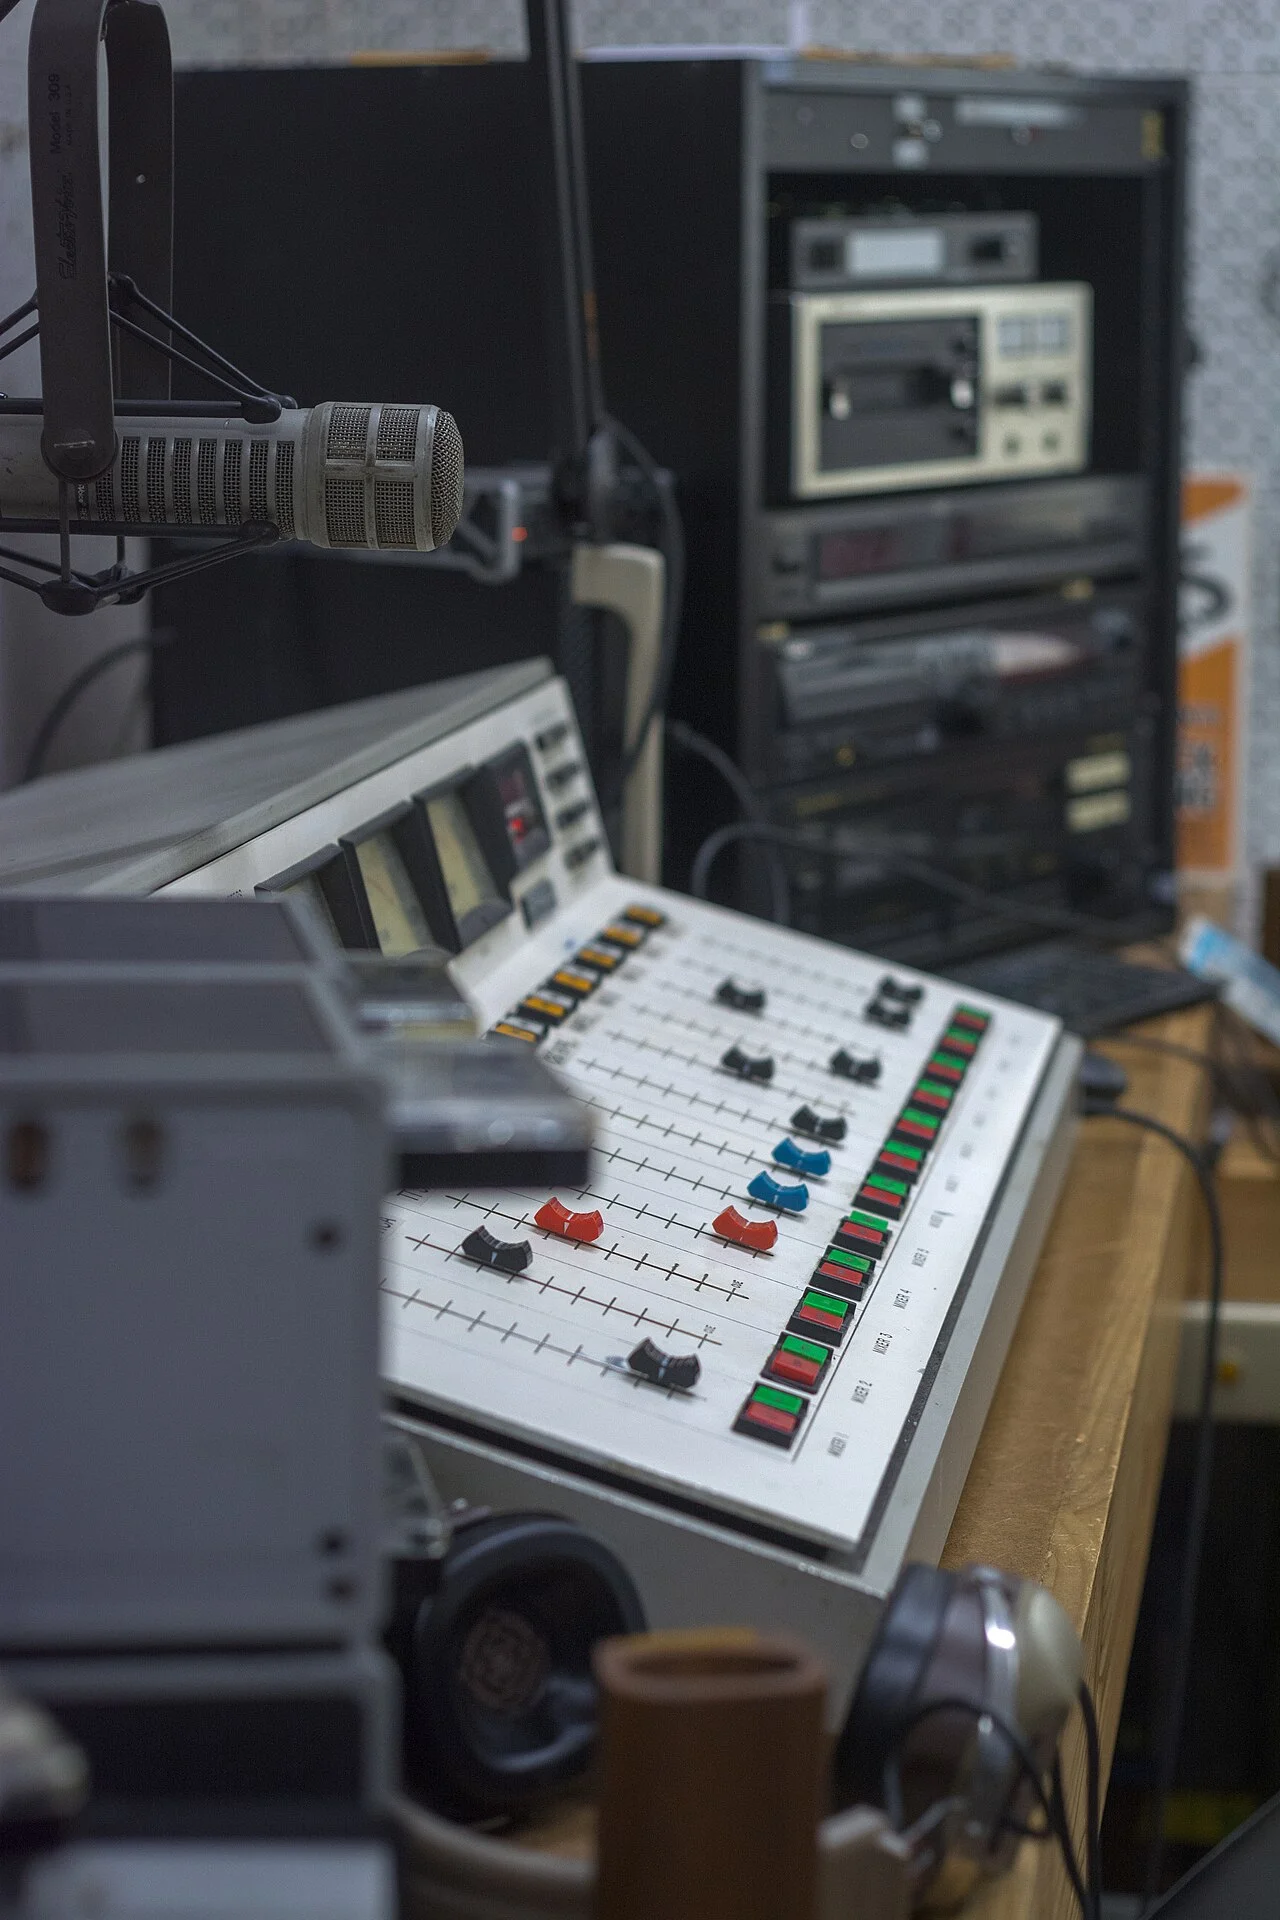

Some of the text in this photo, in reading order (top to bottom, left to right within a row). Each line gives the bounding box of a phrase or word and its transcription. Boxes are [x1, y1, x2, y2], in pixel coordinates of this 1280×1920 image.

[48, 73, 61, 153] Model 309
[892, 1293, 910, 1309] MIXER
[872, 1337, 891, 1355] MIXER
[851, 1385, 870, 1404] MIXER
